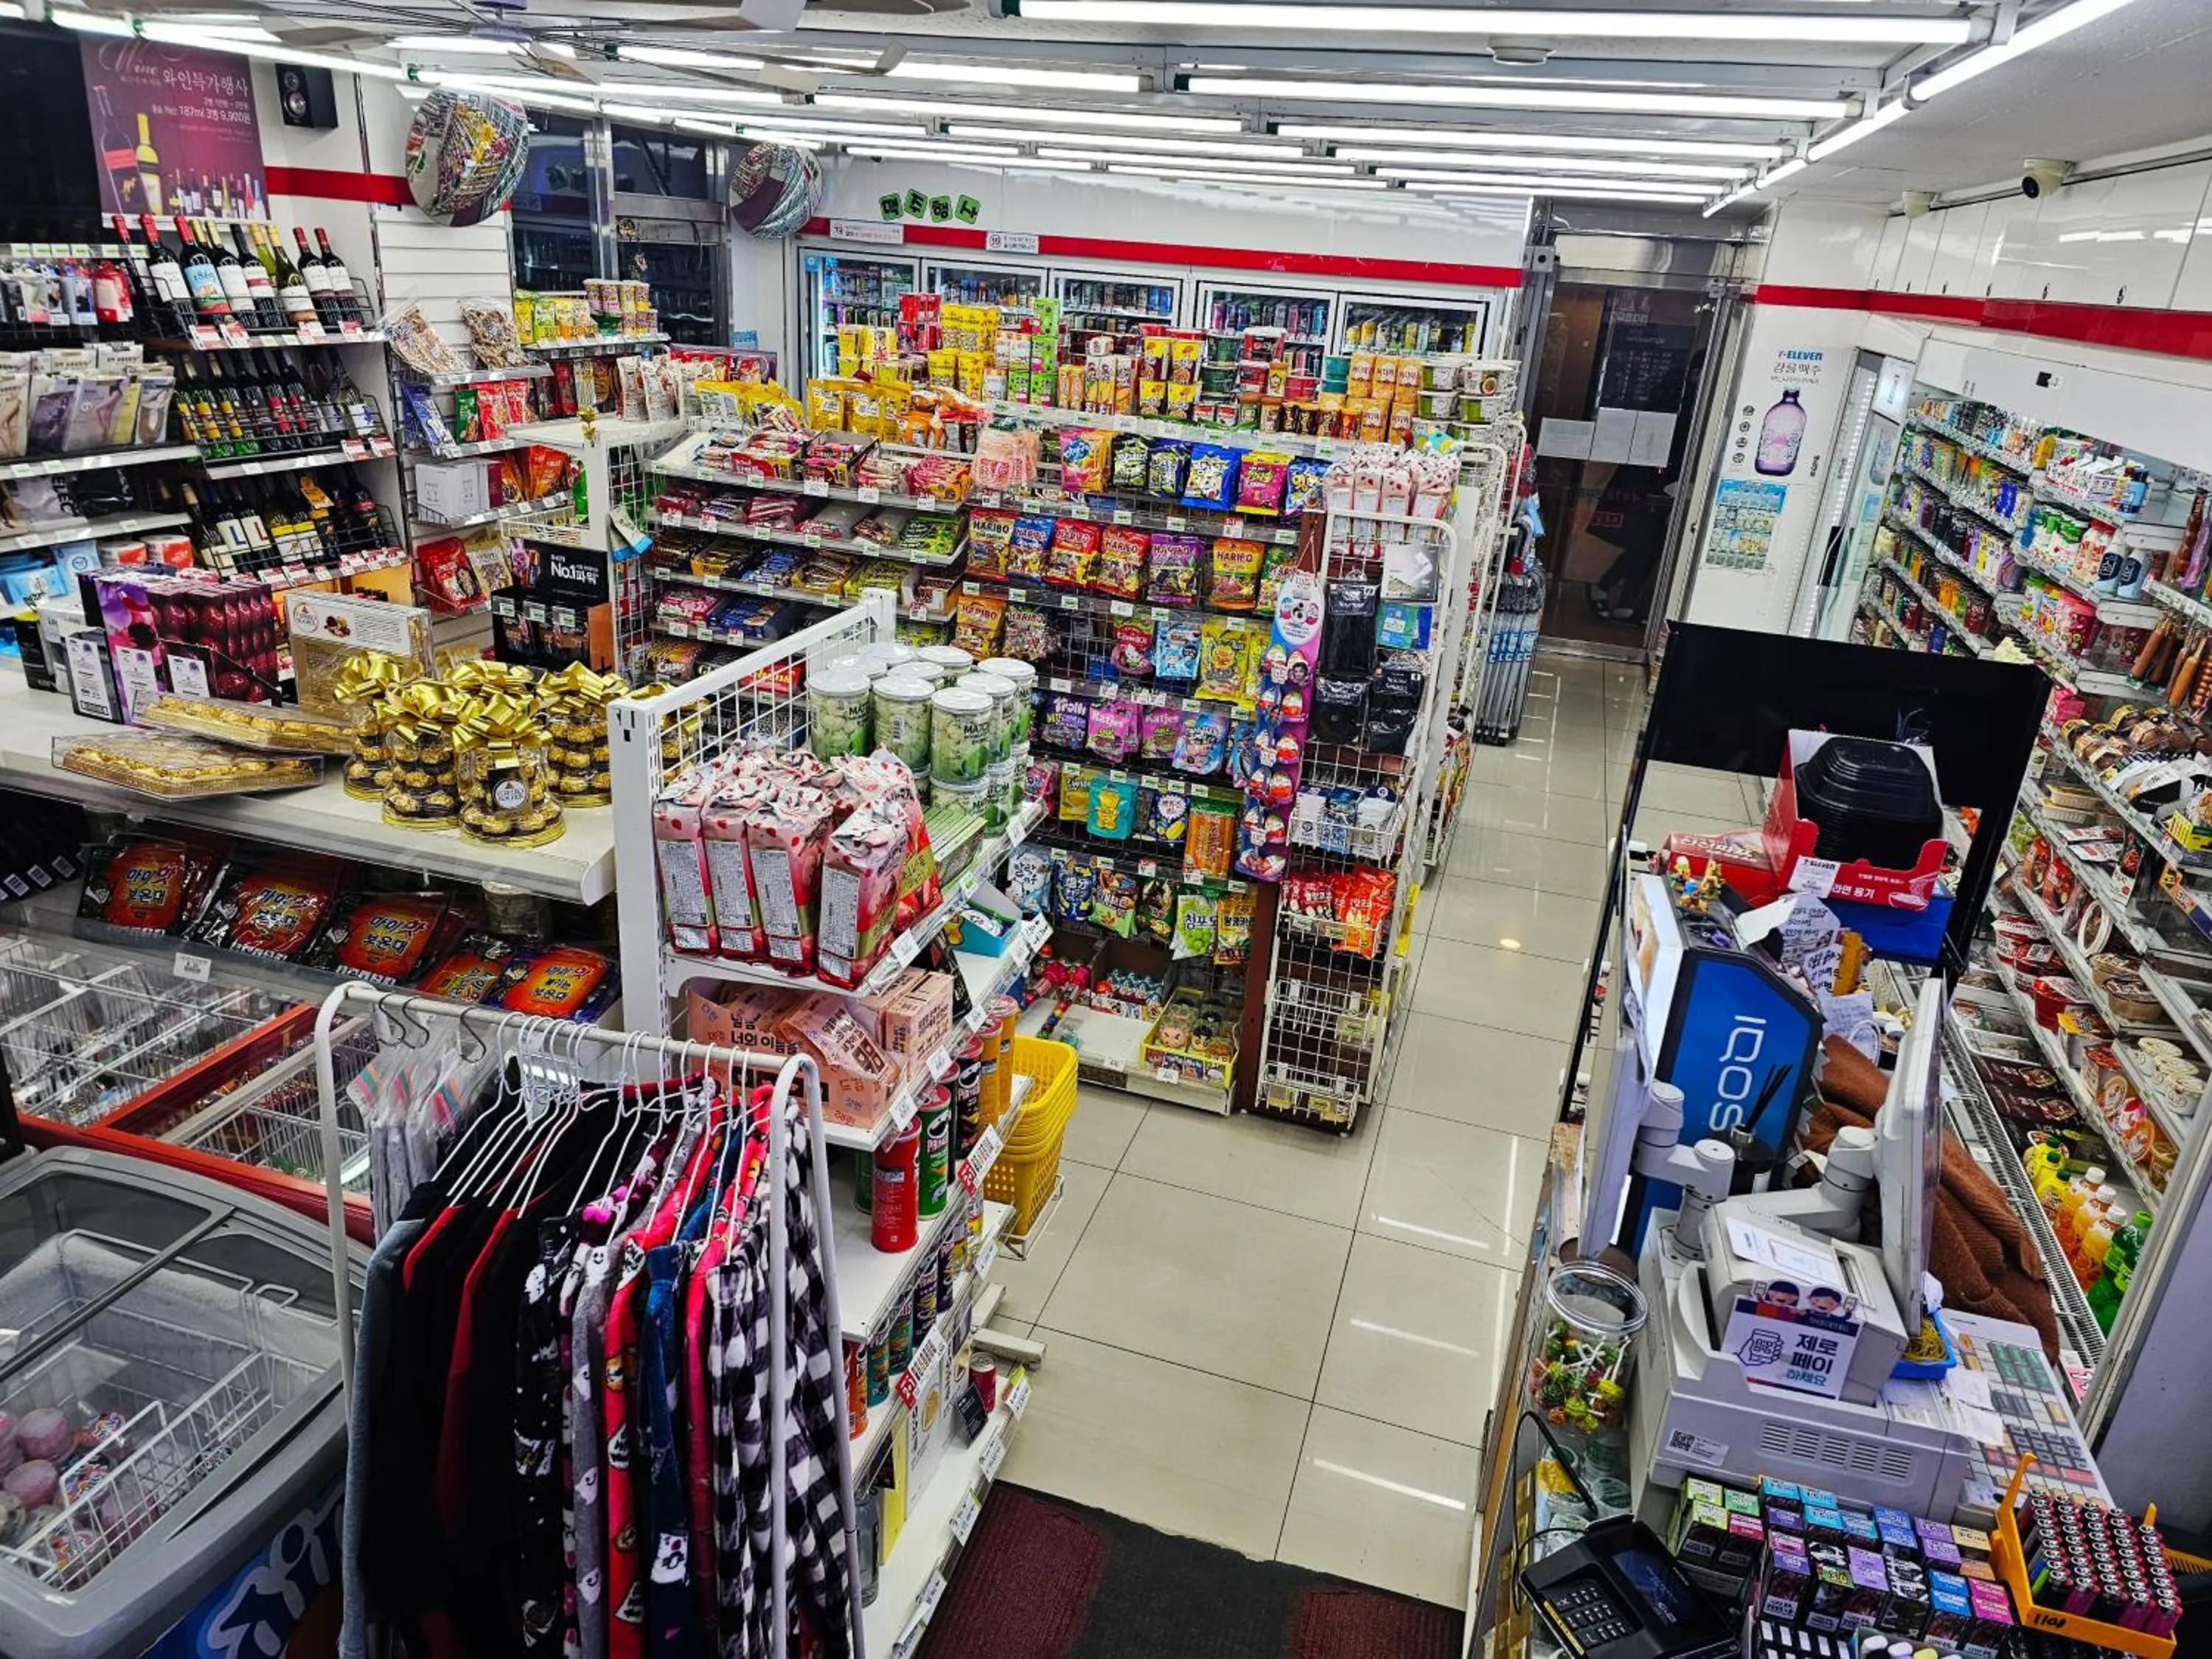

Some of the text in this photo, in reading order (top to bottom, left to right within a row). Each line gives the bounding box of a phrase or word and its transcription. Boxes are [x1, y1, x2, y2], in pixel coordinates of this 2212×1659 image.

[973, 521, 1010, 534] HARIBO
[1217, 551, 1253, 563] HARIBO
[1145, 713, 1180, 726] Katjes
[369, 915, 427, 936] 마이핫
[364, 933, 409, 955] 보온대
[731, 1030, 758, 1047] 너의
[1708, 1014, 1767, 1132] IQOS
[1795, 1333, 1840, 1357] 제로
[1790, 1351, 1834, 1375] 페이
[1785, 1368, 1827, 1387] 하세요
